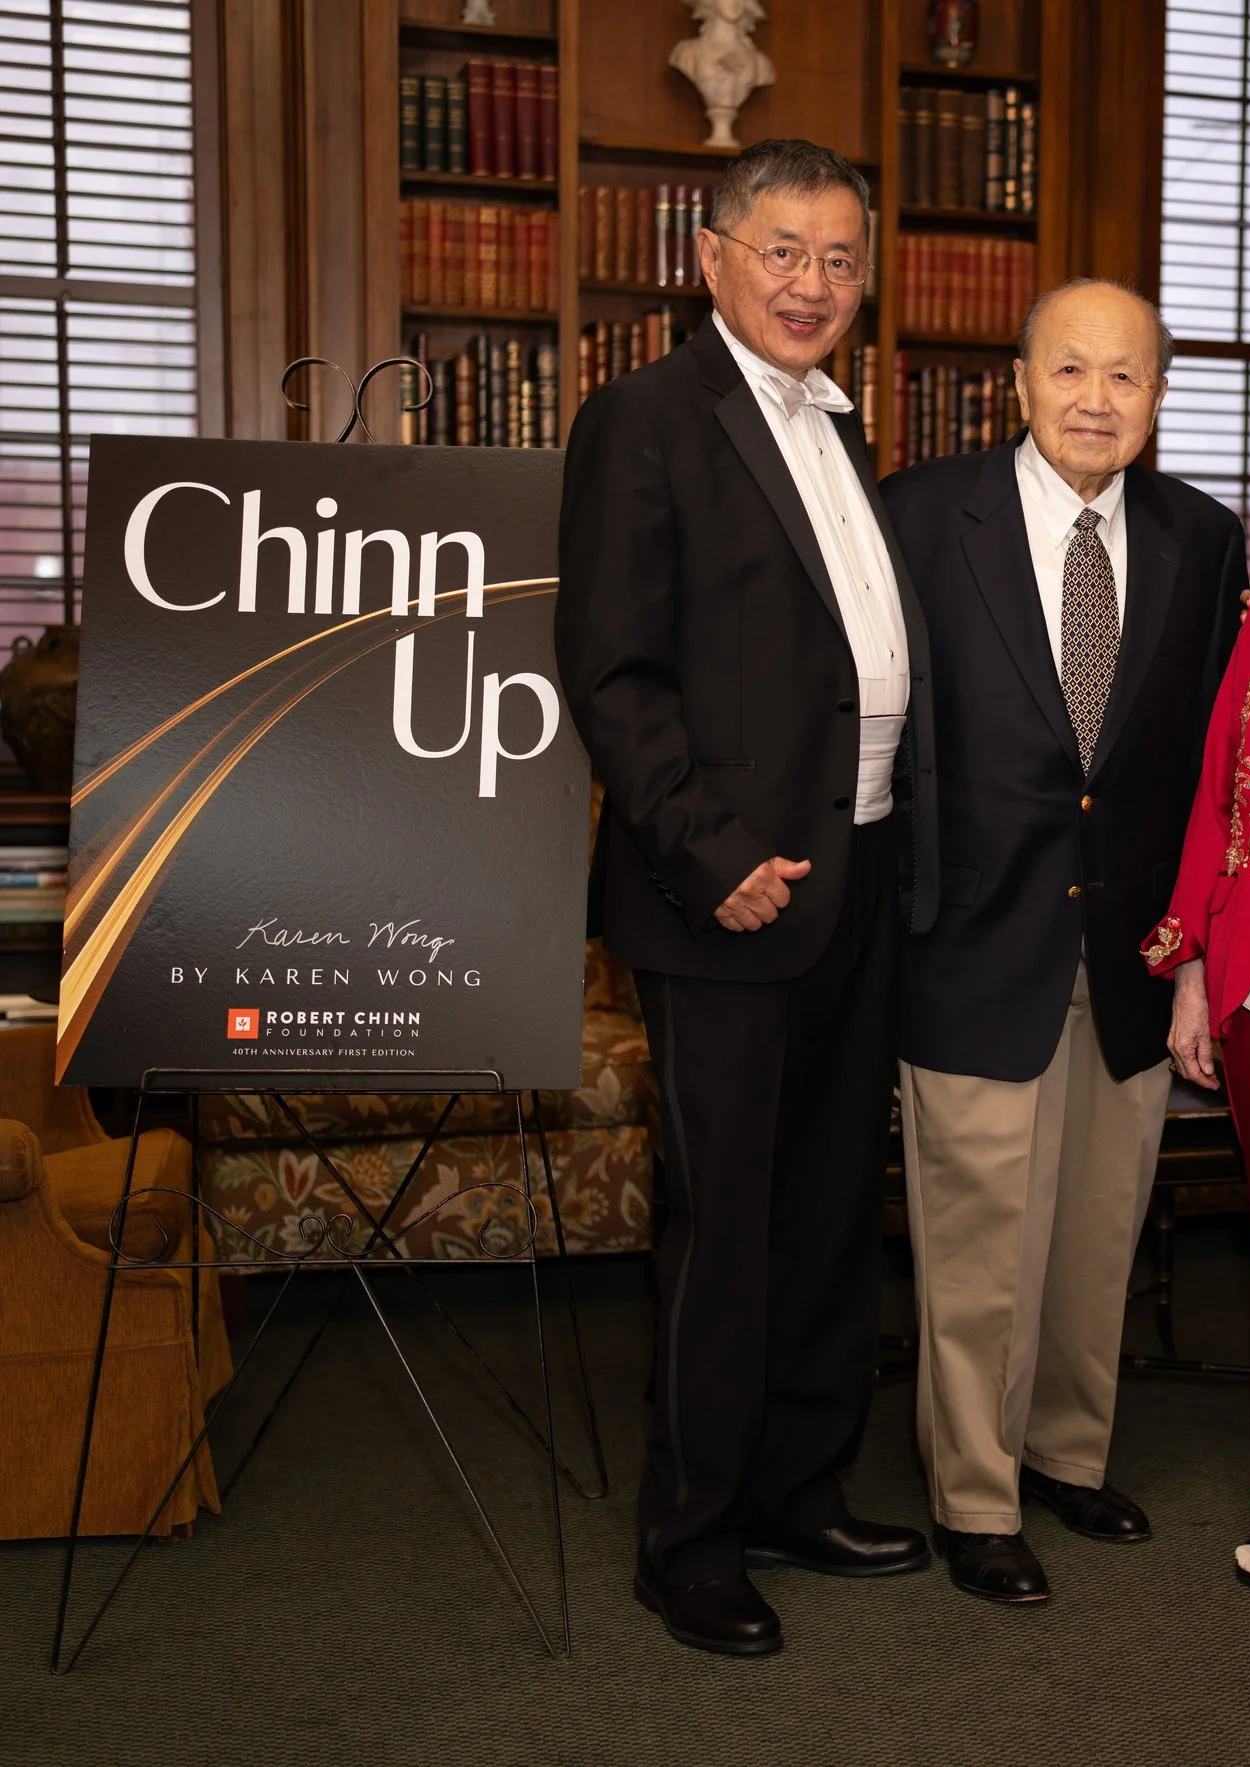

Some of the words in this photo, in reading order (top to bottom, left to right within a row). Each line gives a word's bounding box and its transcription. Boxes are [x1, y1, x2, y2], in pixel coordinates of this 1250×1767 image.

[124, 481, 486, 618] Chinn
[392, 630, 560, 798] Up
[235, 917, 351, 950] Karen
[367, 919, 455, 964] Wong
[171, 967, 208, 984] BY
[236, 967, 349, 985] KAREN
[377, 969, 481, 987] WONG
[266, 1011, 346, 1025] ROBERT
[354, 1011, 420, 1025] CHINN
[266, 1028, 419, 1038] FOUNDATION
[232, 1047, 258, 1056] 40TH
[262, 1048, 333, 1056] ANNIVERSARY
[338, 1048, 366, 1056] FIRST
[371, 1049, 415, 1057] EDITION
